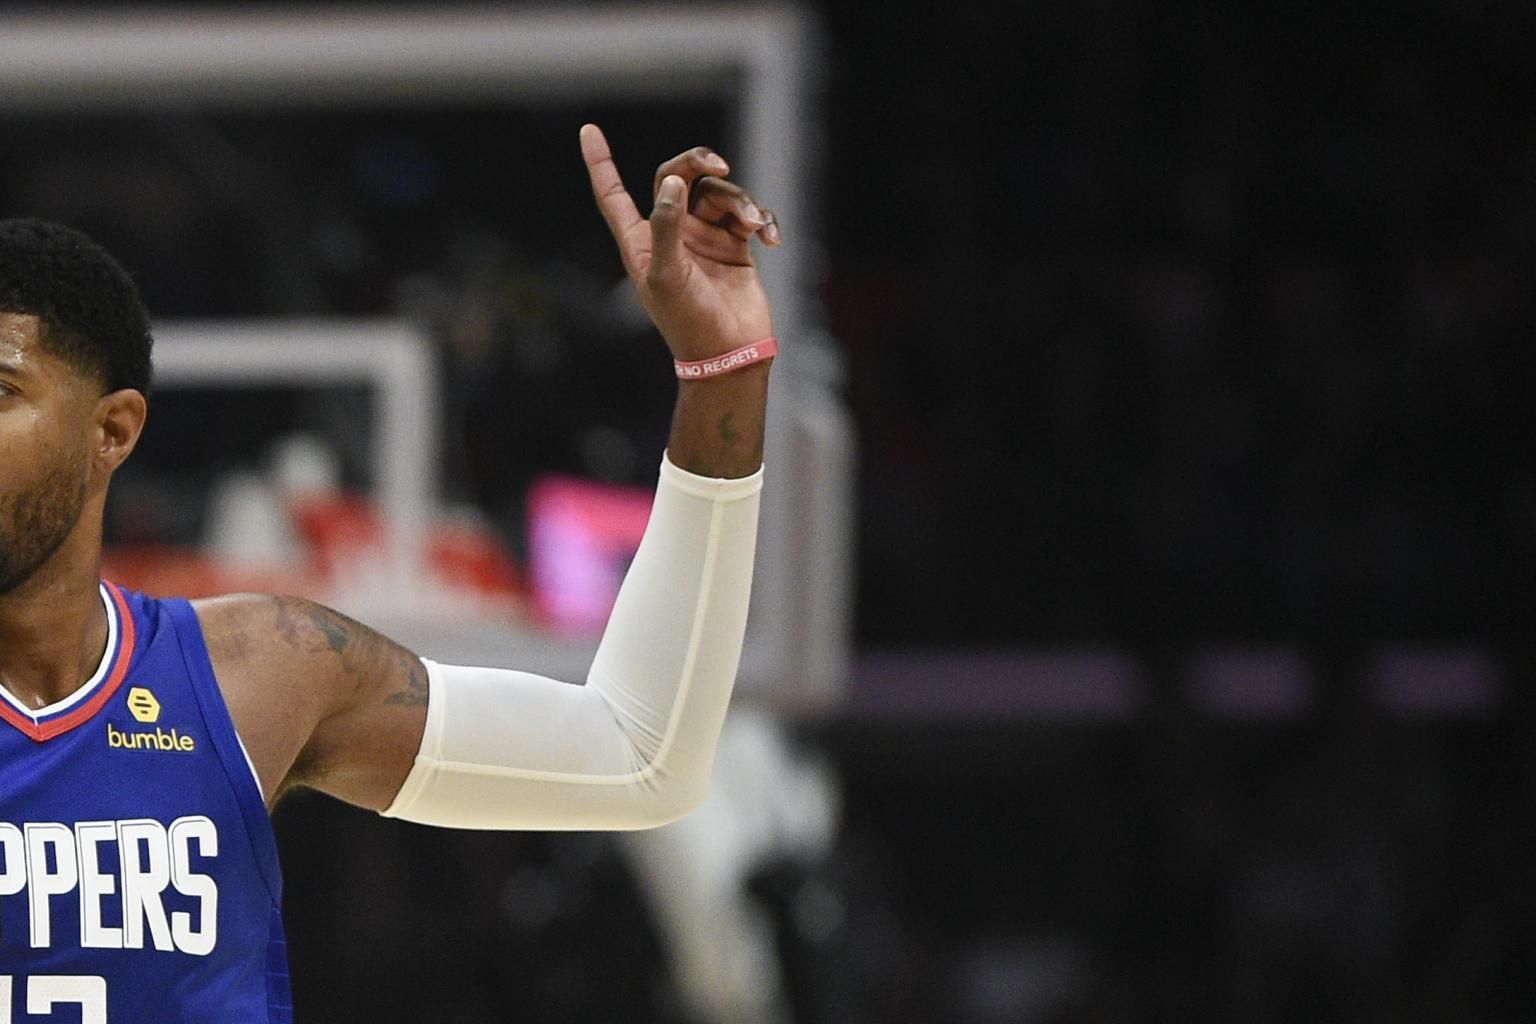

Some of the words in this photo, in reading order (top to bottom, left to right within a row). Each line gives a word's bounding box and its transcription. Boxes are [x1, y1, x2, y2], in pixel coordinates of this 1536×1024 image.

[683, 365, 701, 376] NO
[704, 347, 759, 374] REGRETS
[107, 722, 195, 751] bumble
